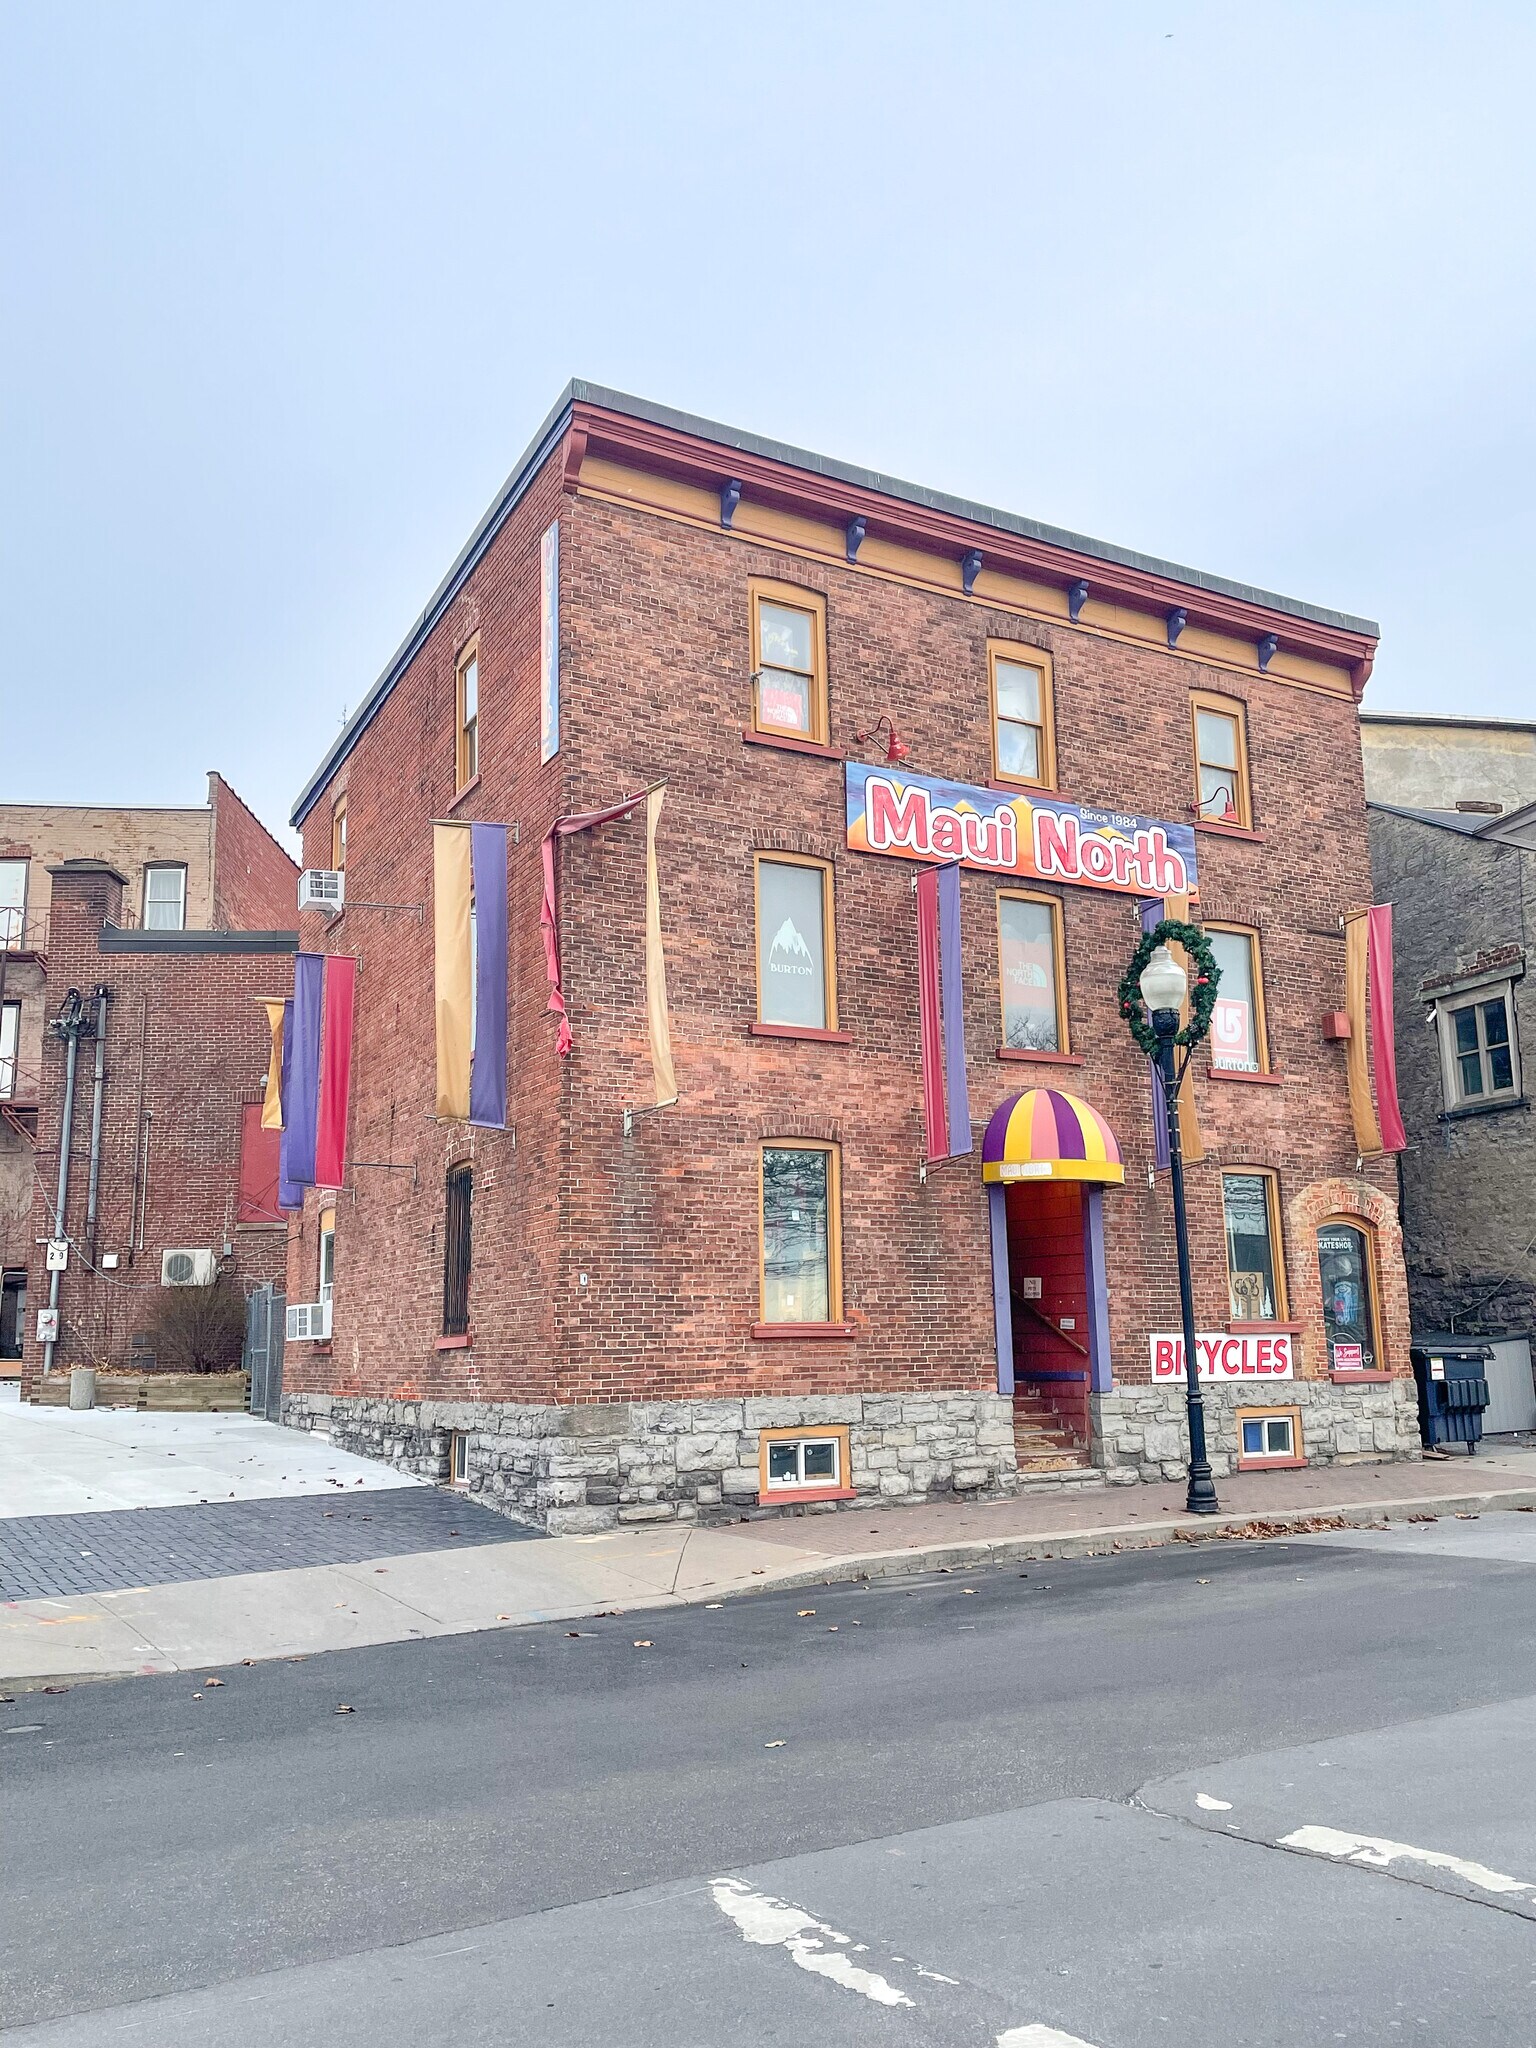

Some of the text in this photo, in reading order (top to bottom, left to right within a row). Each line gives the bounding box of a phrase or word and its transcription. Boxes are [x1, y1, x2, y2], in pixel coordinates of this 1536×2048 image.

[1080, 808, 1137, 828] Since 1984
[866, 777, 1186, 892] Maui North
[770, 963, 813, 976] BURTON
[1018, 961, 1033, 970] THE
[1006, 967, 1033, 978] NORTH
[1014, 976, 1033, 986] FACE
[1318, 1241, 1352, 1250] KATESHOP
